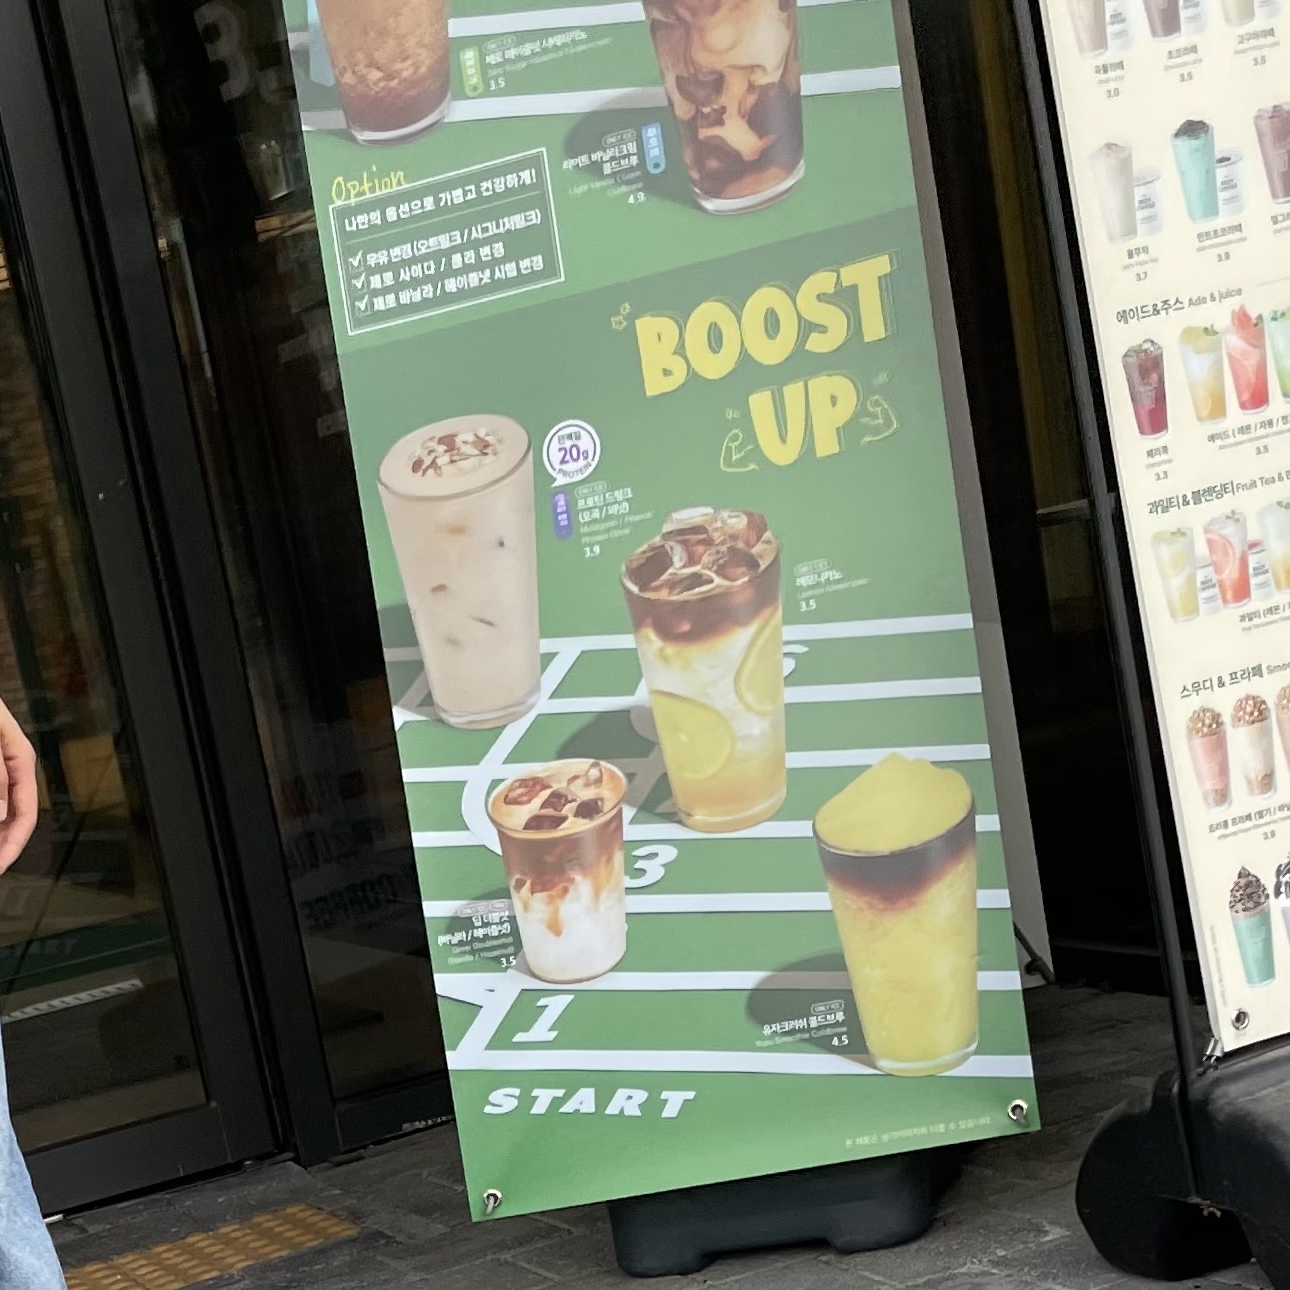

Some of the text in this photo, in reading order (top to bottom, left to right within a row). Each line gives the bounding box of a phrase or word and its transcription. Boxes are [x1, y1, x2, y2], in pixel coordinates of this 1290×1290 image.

[332, 165, 407, 205] Option
[344, 168, 537, 232] 나만의 옵션으로 가볍고 건강하게!
[369, 272, 395, 290] 제로
[399, 260, 436, 282] 사이다
[479, 241, 505, 261] 변경
[635, 252, 895, 397] BOOST
[748, 373, 859, 467] UP
[558, 443, 590, 467] 20g
[1147, 494, 1181, 516] 과일티
[1181, 493, 1191, 507] &
[1191, 480, 1235, 505] 블렌딩티
[625, 844, 679, 889] 3
[500, 955, 517, 968] 3.5
[511, 993, 575, 1043] 1
[831, 1034, 849, 1047] 4.5
[483, 1087, 697, 1119] START
